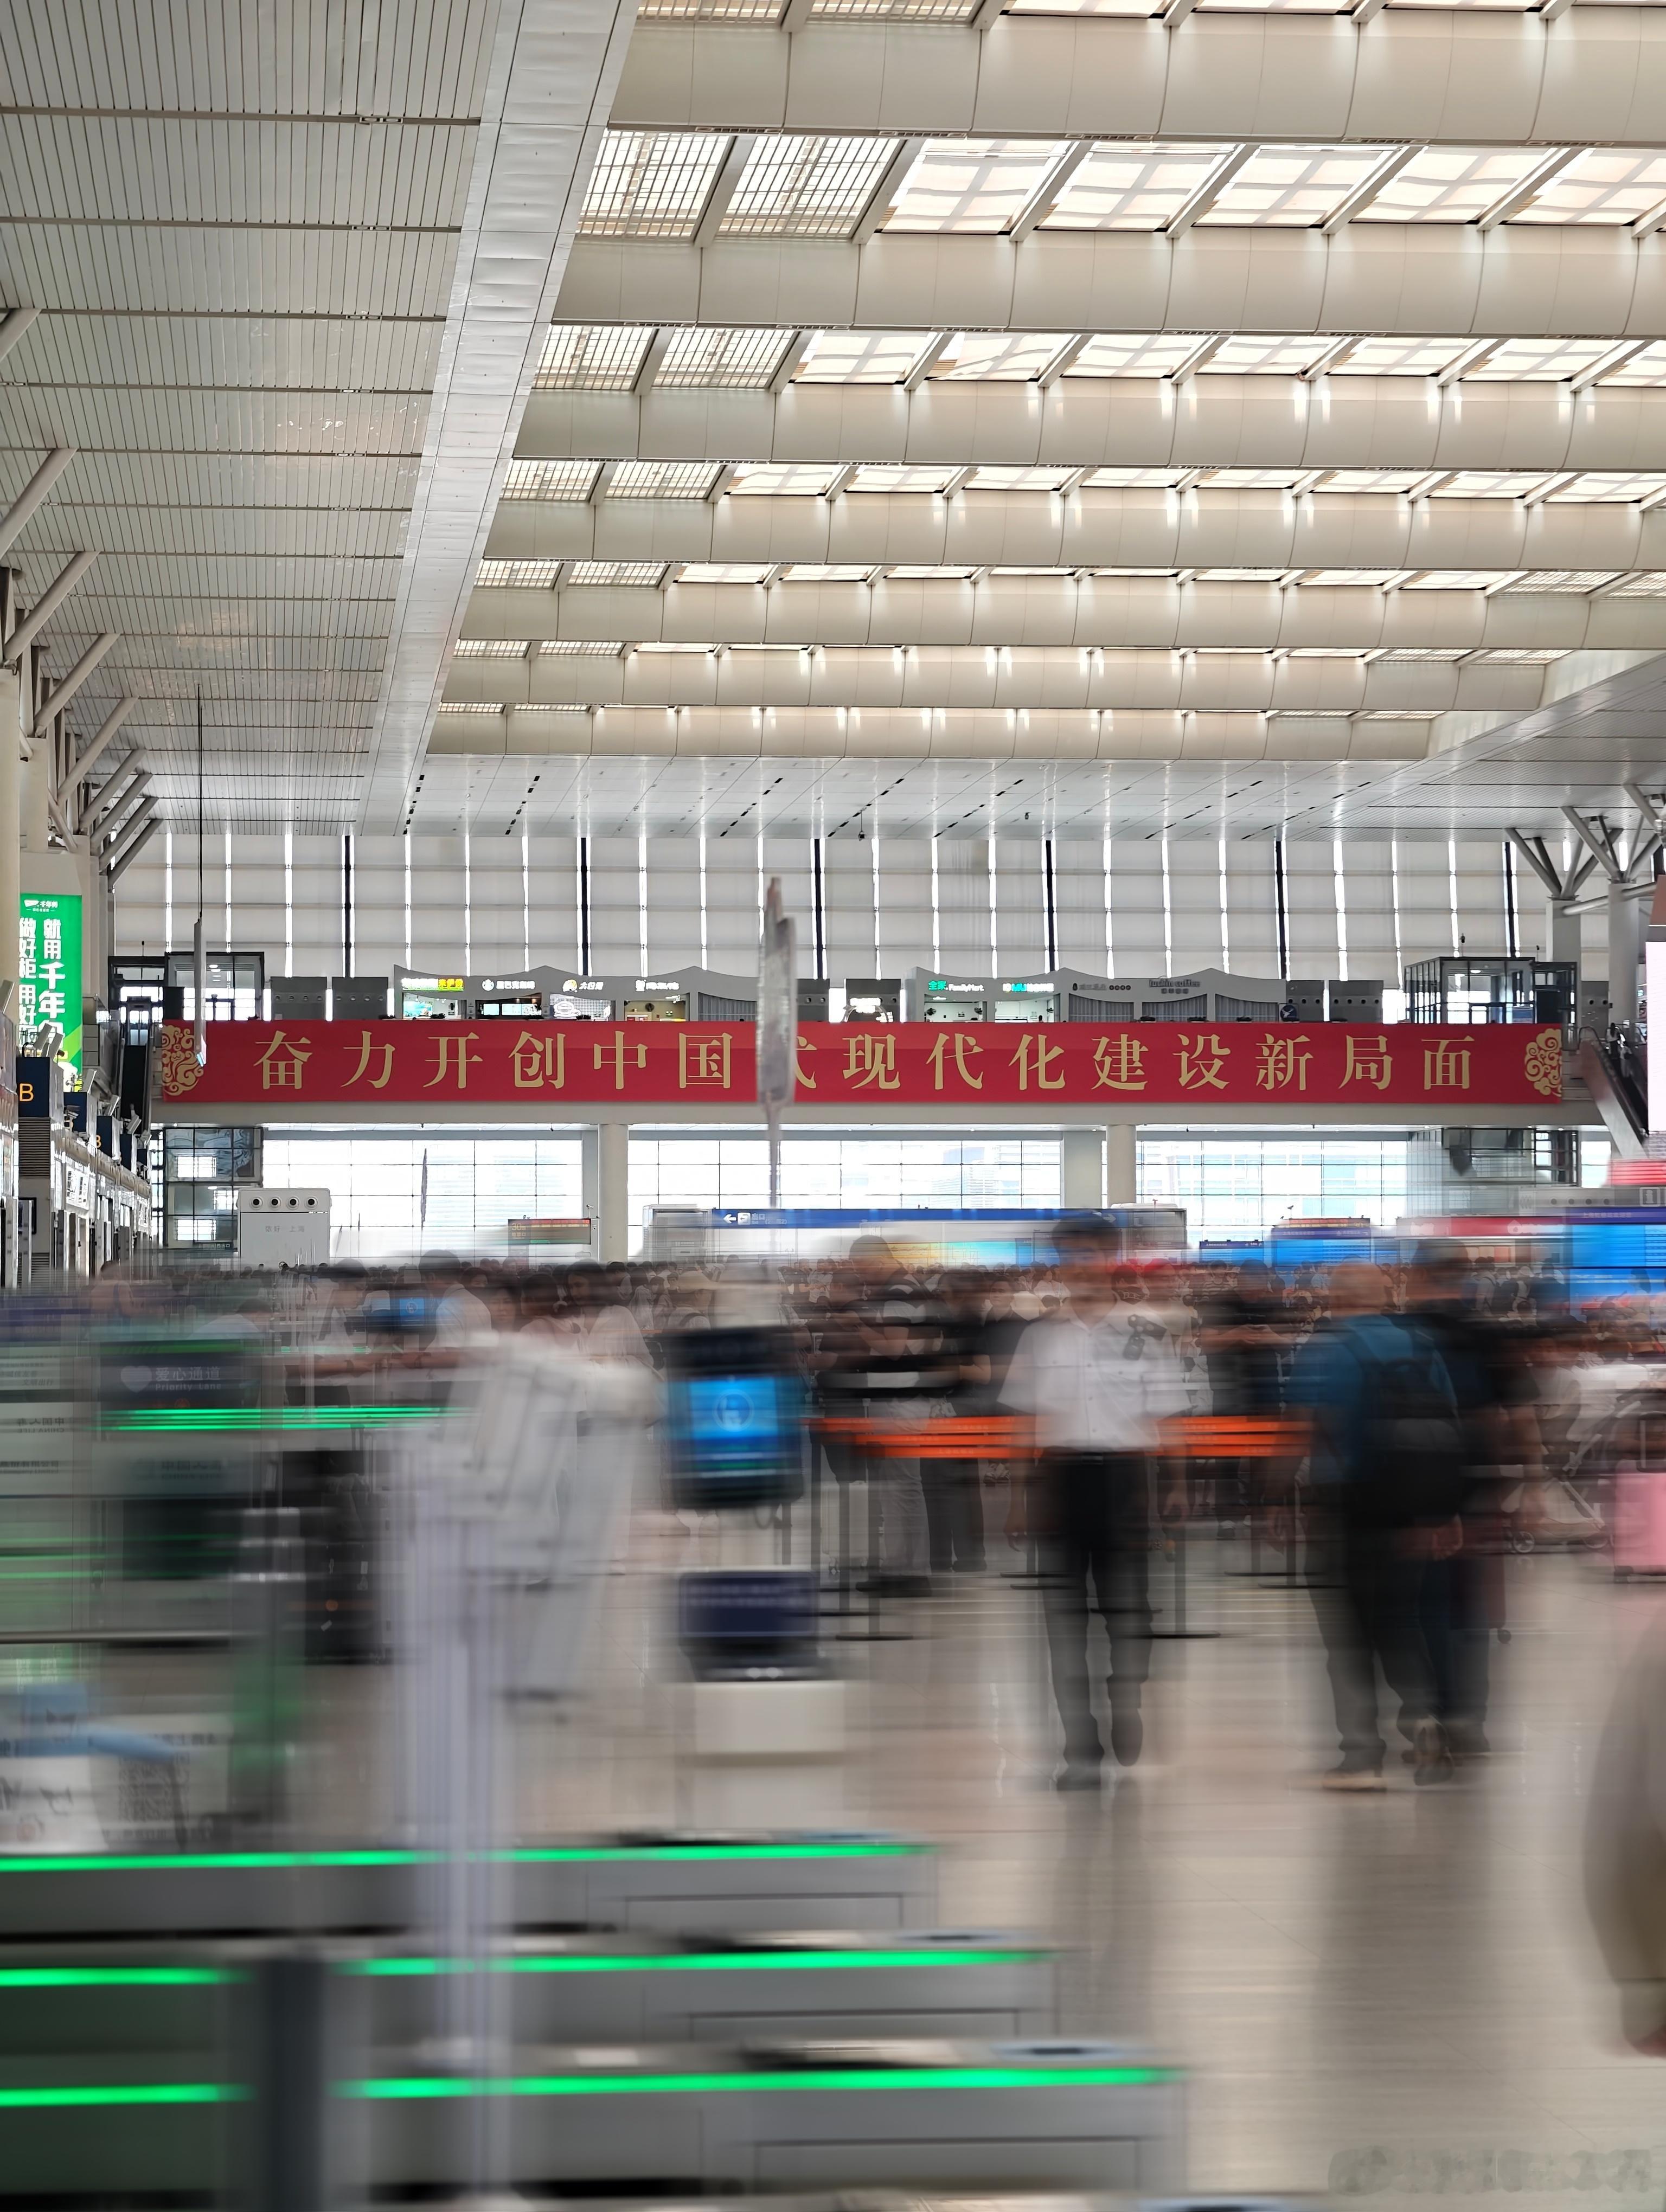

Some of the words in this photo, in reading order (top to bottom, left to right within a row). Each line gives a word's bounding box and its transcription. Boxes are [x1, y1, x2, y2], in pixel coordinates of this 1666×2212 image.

[928, 980, 946, 991] 全家
[20, 1083, 34, 1102] B
[156, 1366, 221, 1381] 爱心通道
[156, 1383, 192, 1391] Priority
